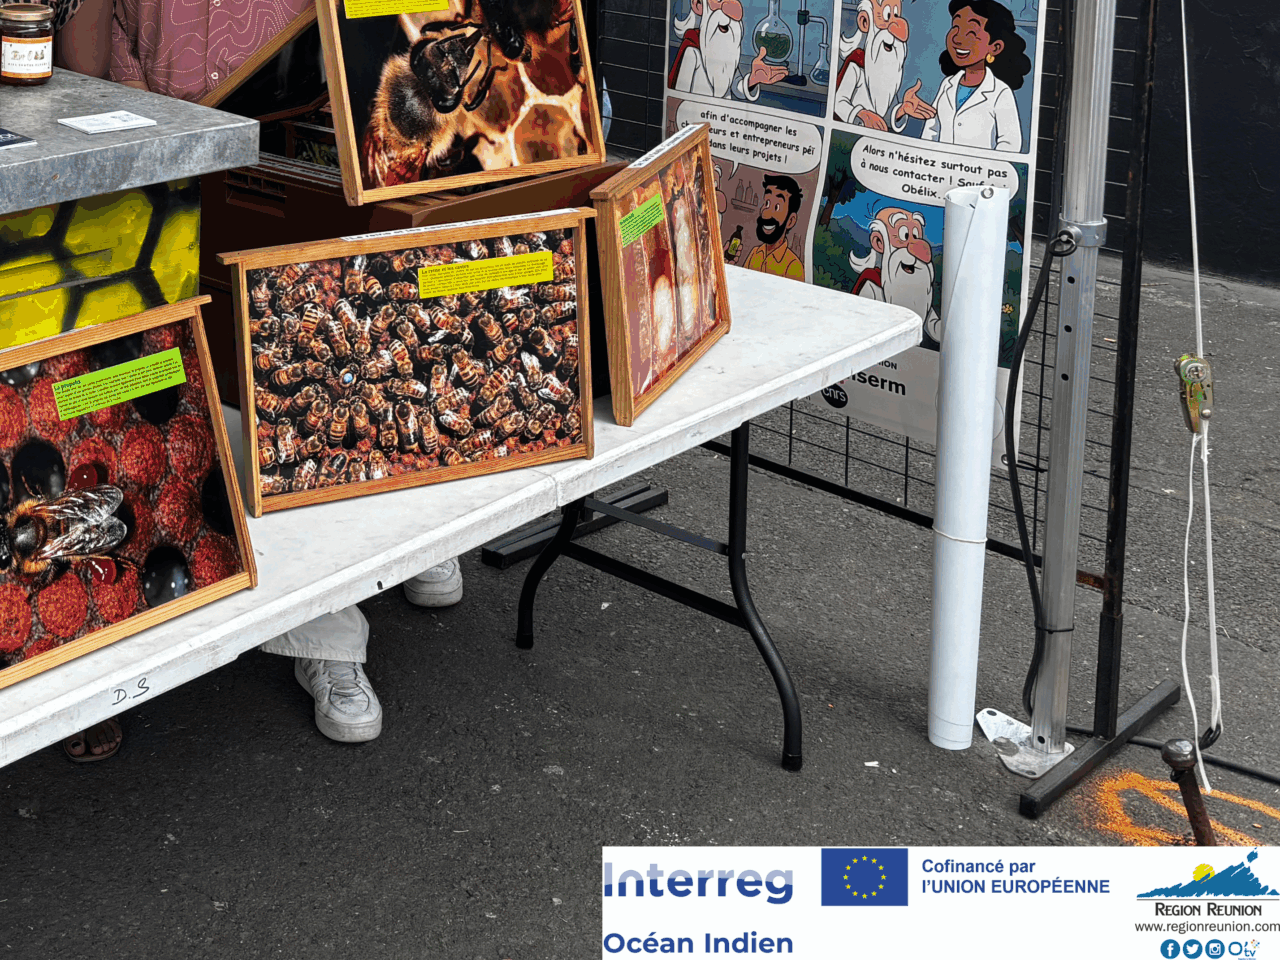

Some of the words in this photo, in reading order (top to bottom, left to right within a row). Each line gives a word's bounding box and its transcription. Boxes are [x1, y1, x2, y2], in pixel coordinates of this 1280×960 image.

[700, 111, 718, 121] afin
[720, 114, 782, 133] d'accompagner
[785, 126, 797, 137] les
[729, 143, 750, 155] leurs
[752, 150, 782, 163] projets
[730, 130, 740, 139] et
[742, 133, 799, 152] entrepreneurs
[802, 145, 816, 156] péï
[860, 158, 866, 168] à
[869, 163, 889, 174] nous
[892, 168, 945, 184] contacter
[862, 144, 885, 157] Alors
[888, 150, 936, 167] n'hésitez
[941, 161, 983, 175] surtout
[987, 168, 1008, 179] pas
[822, 386, 847, 403] cnrs
[847, 370, 906, 397] serm
